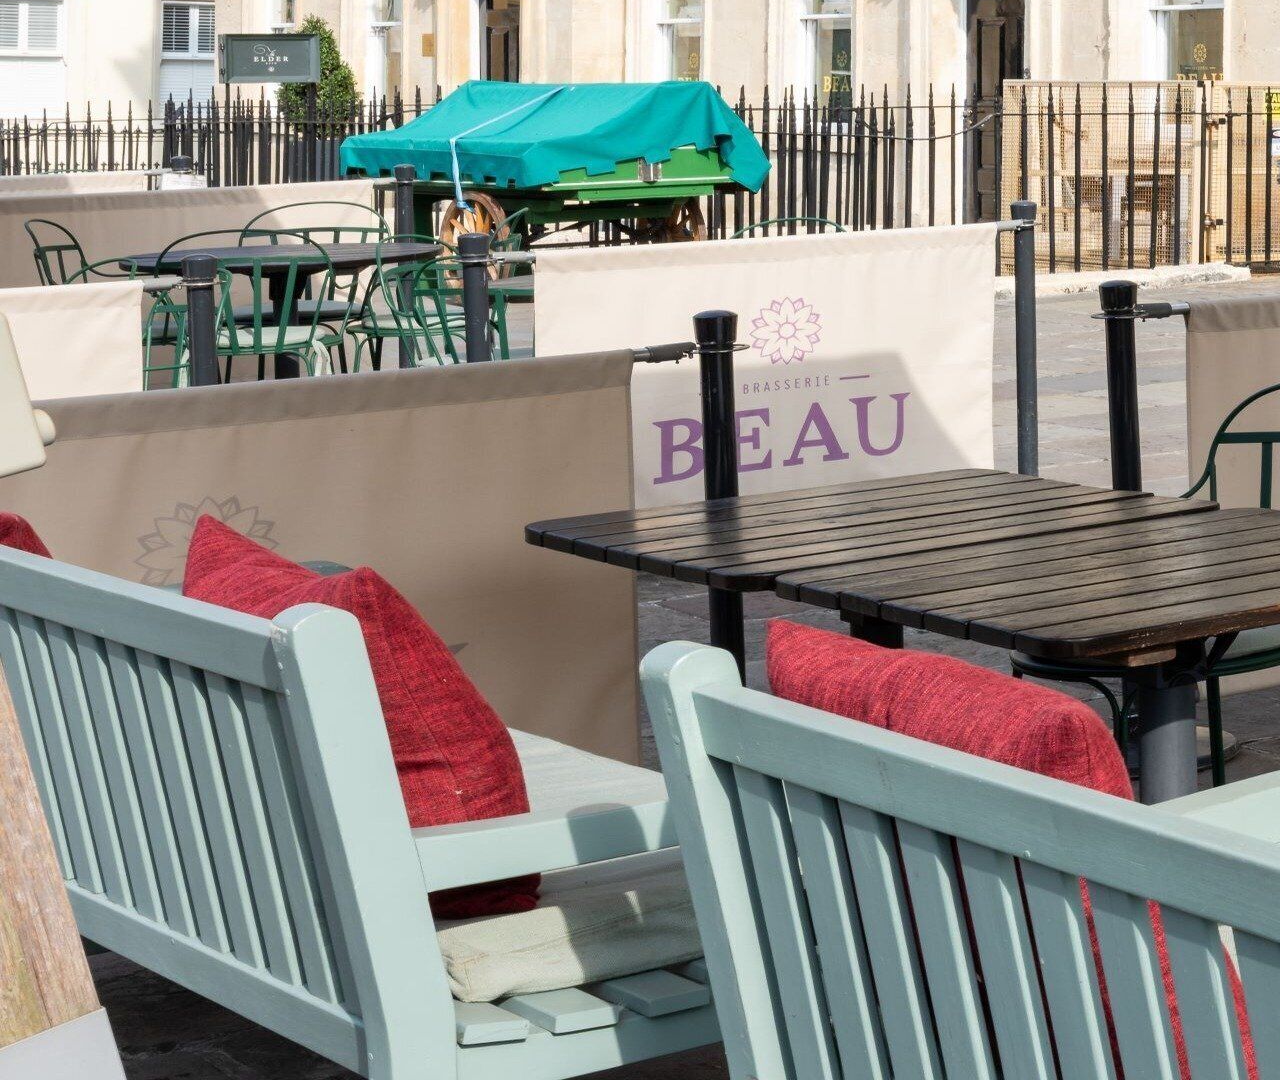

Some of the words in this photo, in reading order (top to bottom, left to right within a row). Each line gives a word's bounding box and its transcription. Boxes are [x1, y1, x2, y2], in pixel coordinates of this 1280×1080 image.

[253, 55, 289, 63] ELDER
[742, 374, 832, 395] BRASSERIE
[651, 392, 912, 486] BEAU
